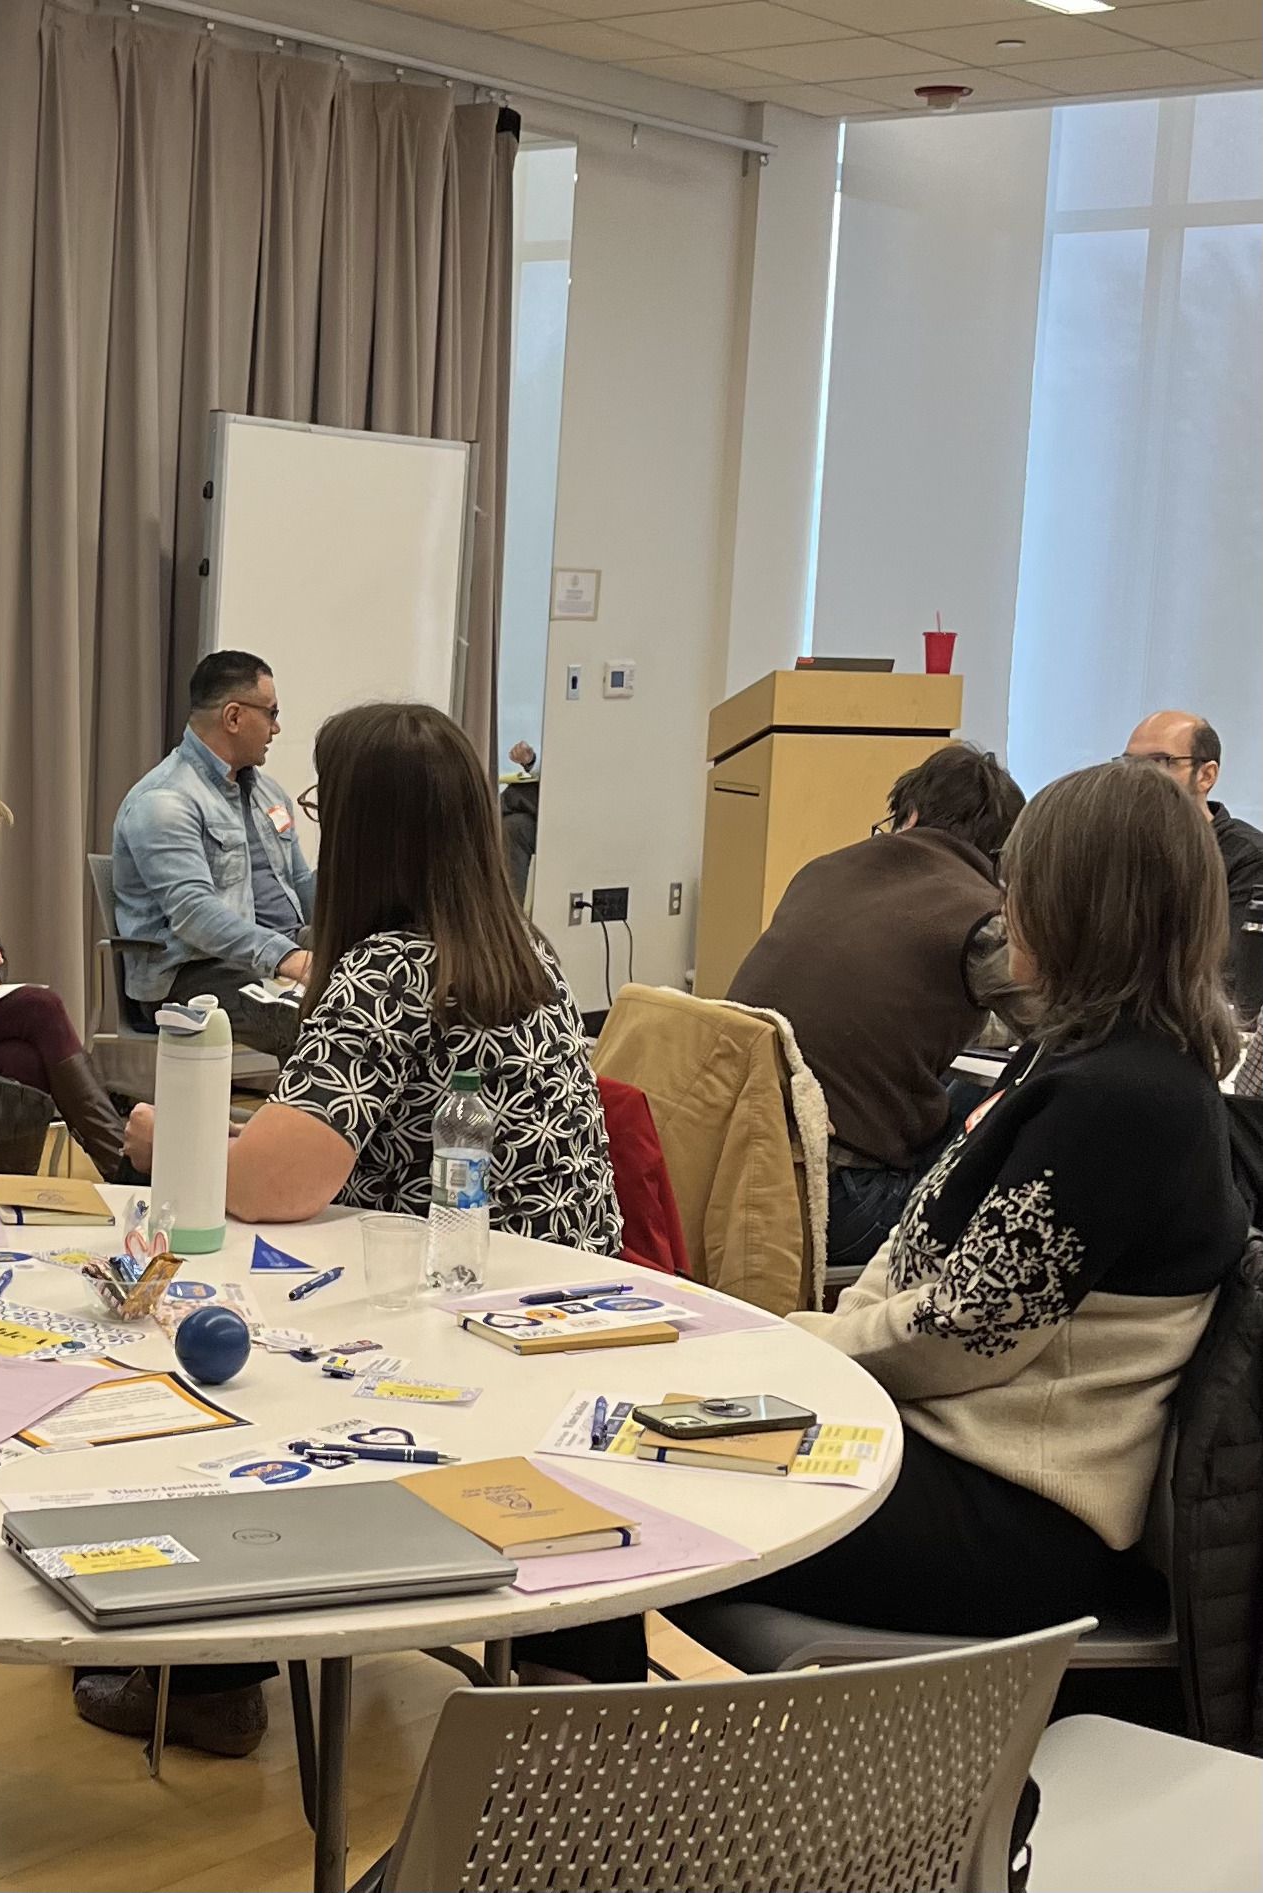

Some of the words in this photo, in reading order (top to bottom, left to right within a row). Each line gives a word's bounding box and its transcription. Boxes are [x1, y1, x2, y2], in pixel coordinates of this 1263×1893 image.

[108, 1487, 158, 1495] Winter
[161, 1483, 221, 1491] Institute
[81, 1548, 125, 1559] Table
